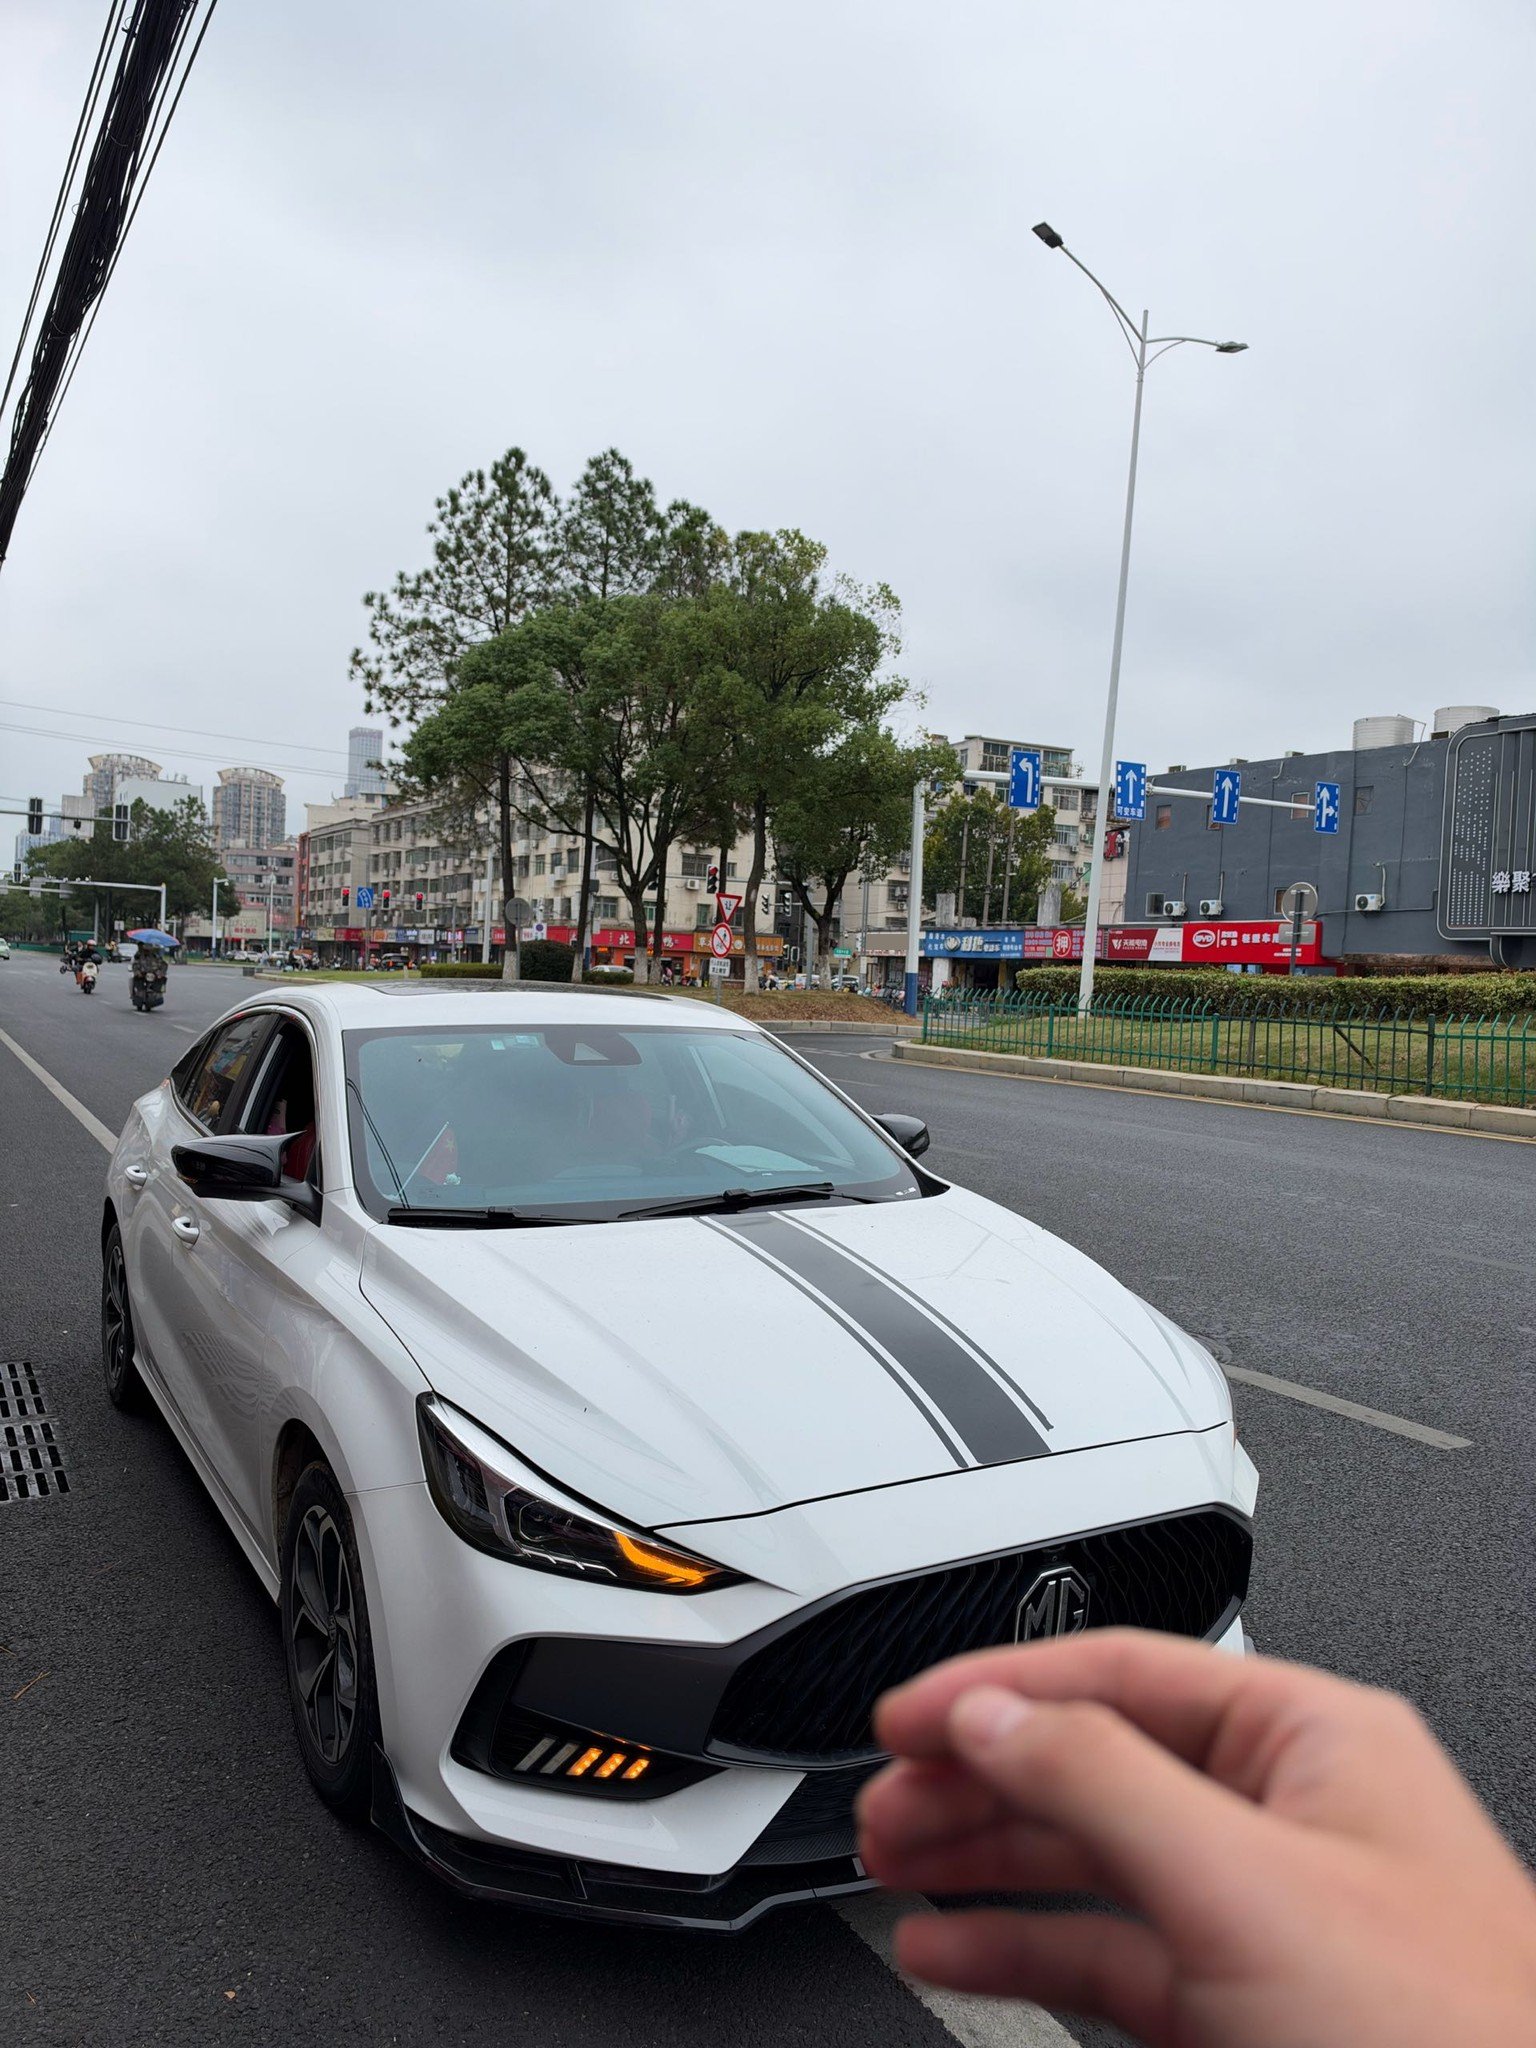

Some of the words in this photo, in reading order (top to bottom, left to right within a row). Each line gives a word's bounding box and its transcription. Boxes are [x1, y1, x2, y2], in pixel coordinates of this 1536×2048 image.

[1117, 806, 1143, 818] 可变车道
[1492, 870, 1536, 894] 樂聚
[724, 900, 732, 911] 让
[1056, 935, 1069, 953] 押
[1194, 934, 1213, 943] BYD
[1023, 1577, 1085, 1641] MG
